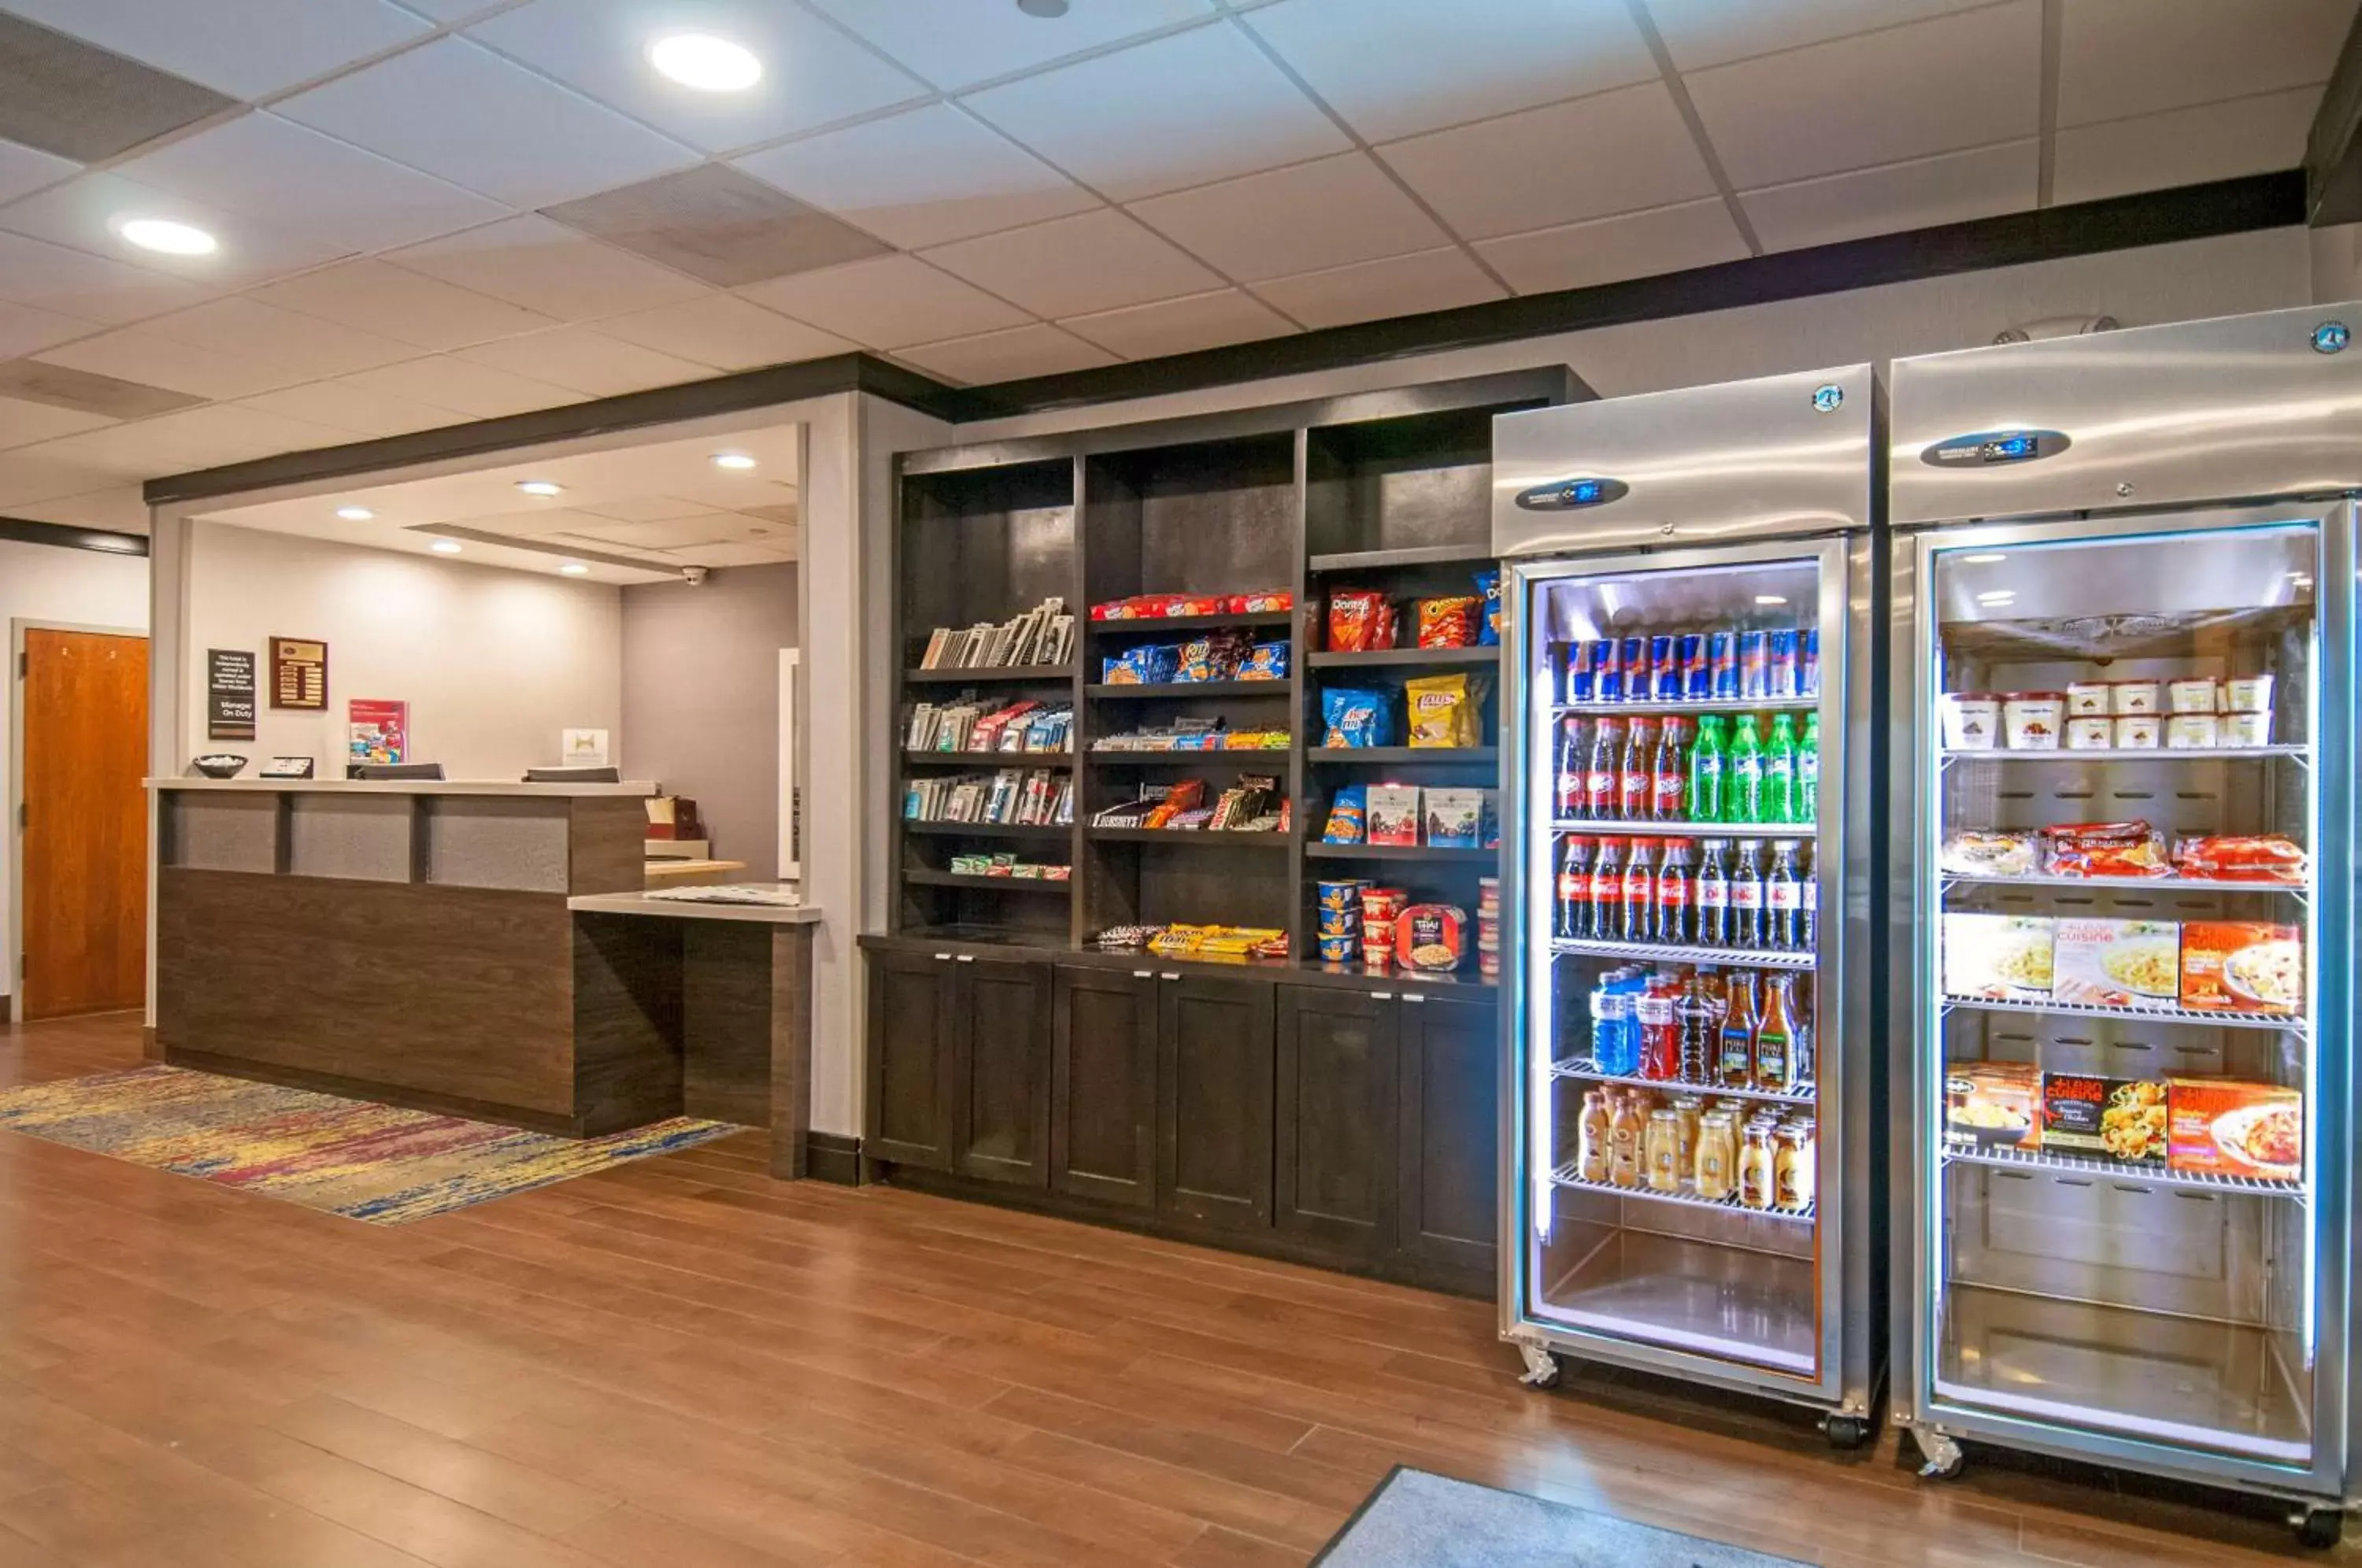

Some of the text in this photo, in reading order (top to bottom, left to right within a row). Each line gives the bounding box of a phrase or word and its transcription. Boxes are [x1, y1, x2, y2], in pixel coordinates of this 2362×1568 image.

[1332, 599, 1369, 612] Doritos
[221, 701, 252, 710] Manager
[1416, 919, 1439, 930] THAI
[2057, 931, 2114, 944] cuisine
[2045, 1086, 2103, 1101] cuisine
